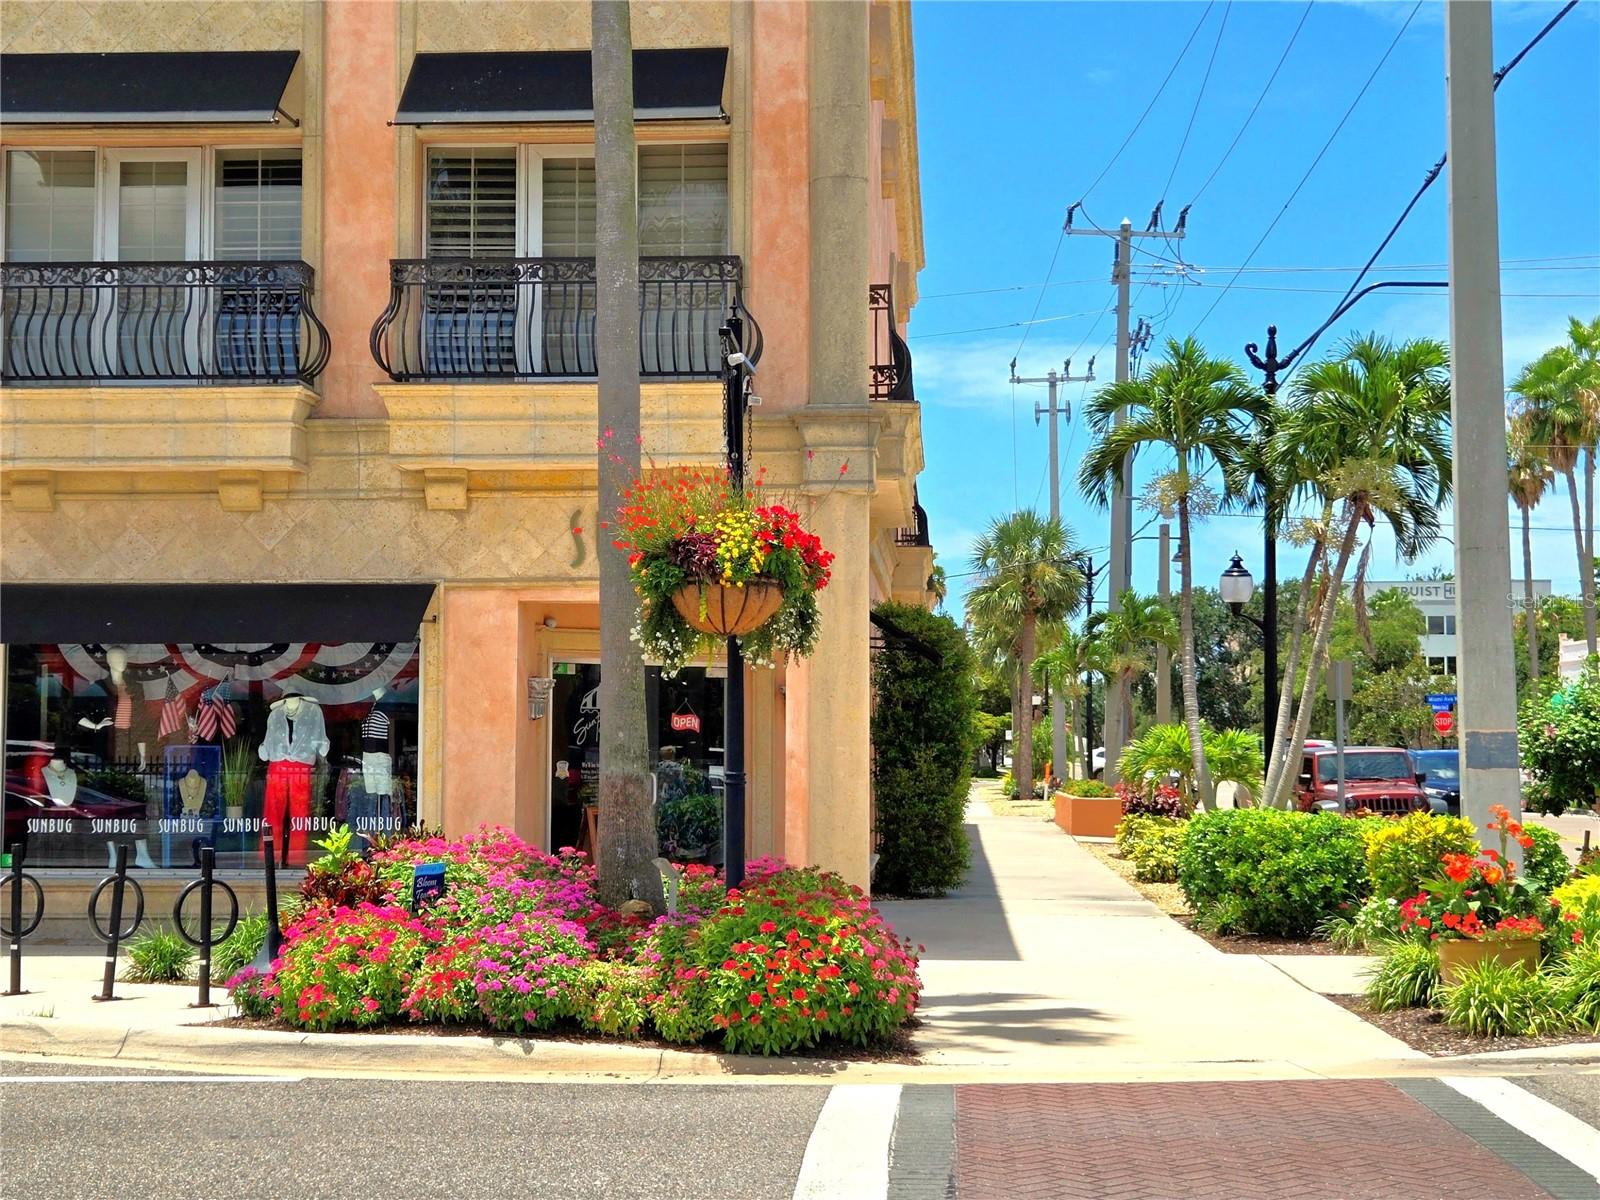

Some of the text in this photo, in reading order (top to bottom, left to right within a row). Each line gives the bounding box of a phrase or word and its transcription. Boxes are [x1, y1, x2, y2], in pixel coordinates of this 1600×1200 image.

[673, 716, 698, 729] OPEN
[1435, 717, 1452, 726] STOP
[27, 818, 72, 834] SUNBUG
[91, 818, 137, 834] SUNBUG
[158, 818, 204, 833] SUNBUG
[290, 816, 336, 832] SUNBUG
[355, 816, 401, 832] SUNBUG
